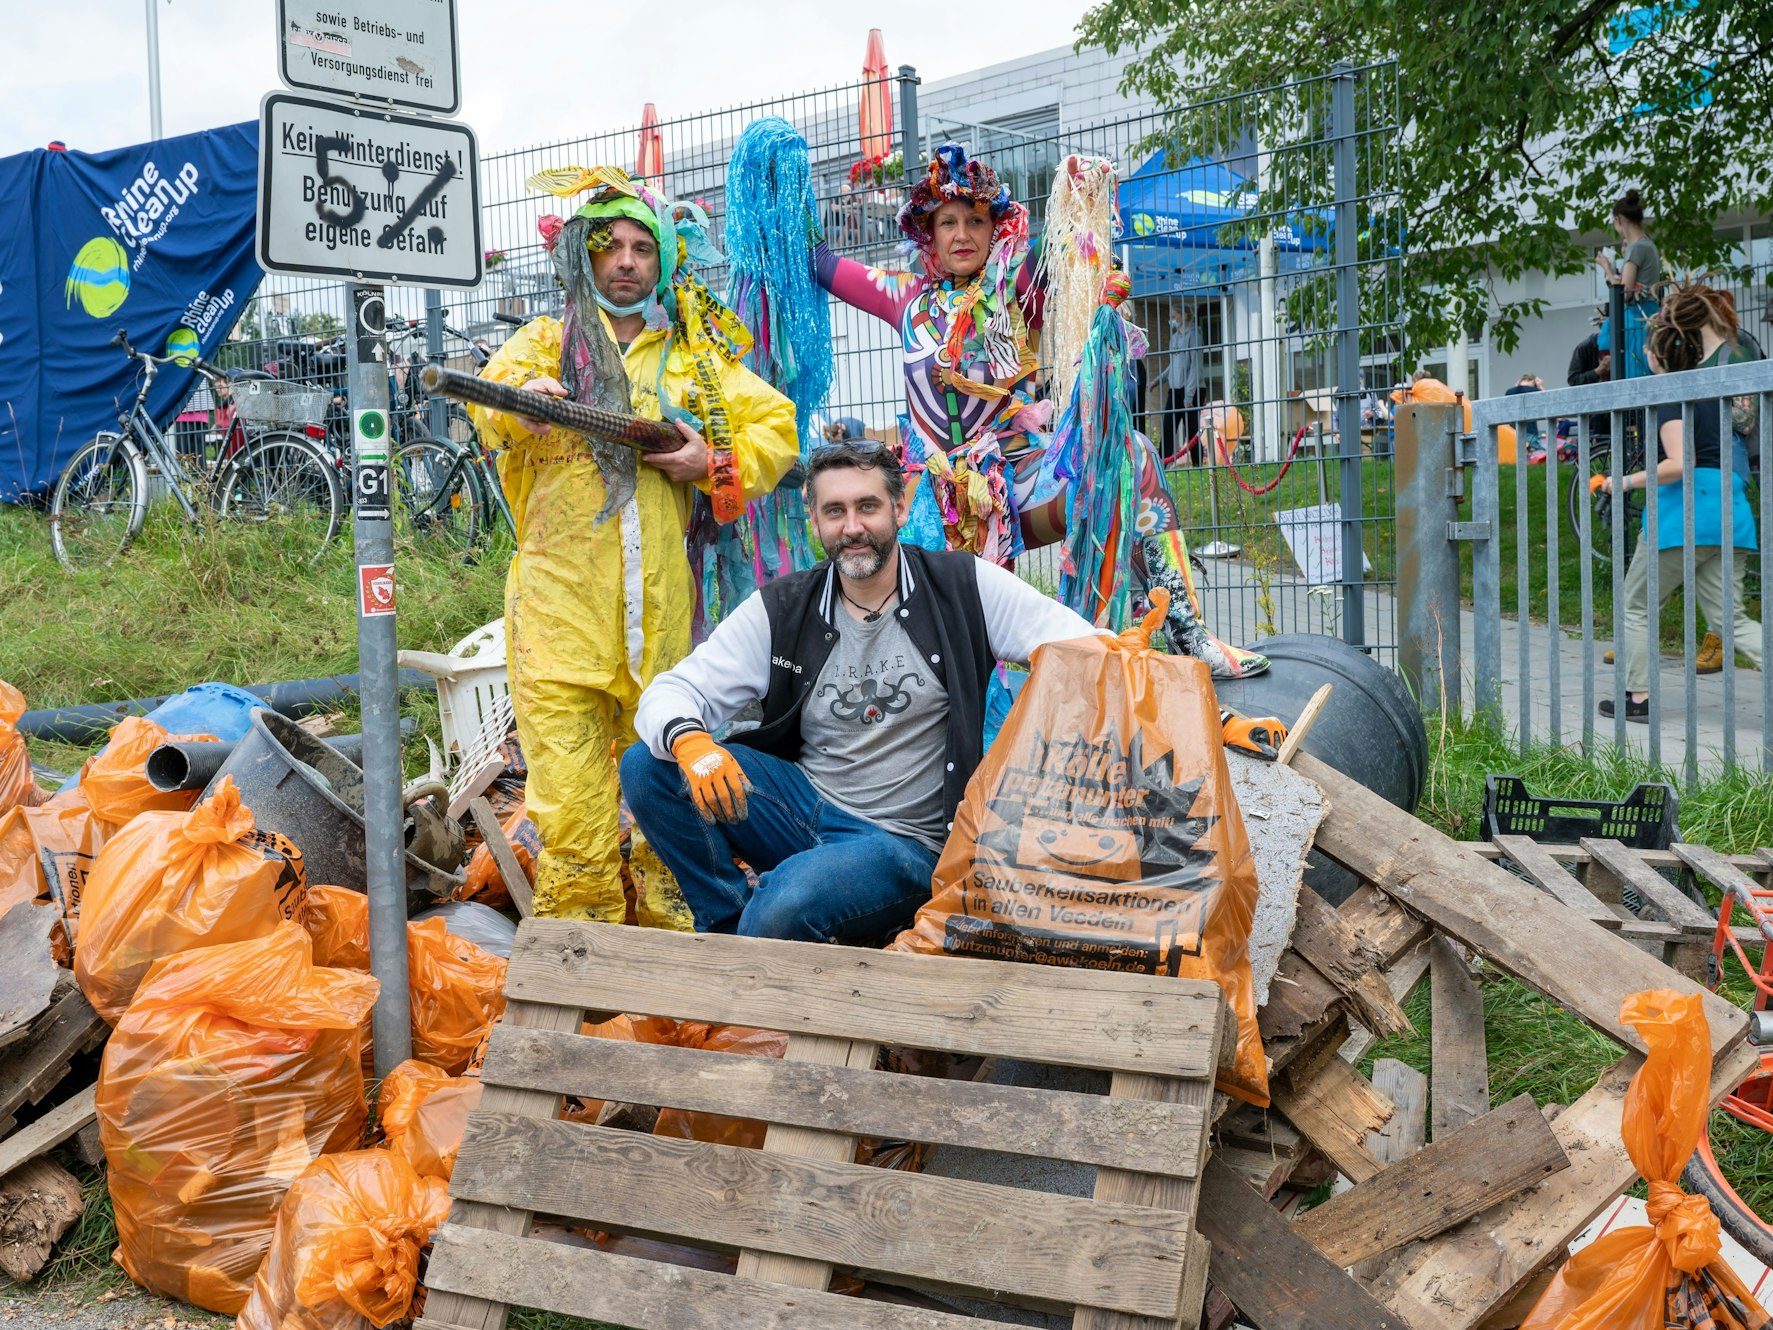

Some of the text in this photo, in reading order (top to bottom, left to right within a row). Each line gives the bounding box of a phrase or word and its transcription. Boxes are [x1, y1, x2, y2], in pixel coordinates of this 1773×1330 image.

[316, 11, 347, 28] sowie
[353, 17, 402, 39] Betriebs-
[406, 31, 425, 45] und
[311, 52, 433, 89] Versorgungsdienst frei
[282, 121, 326, 154] Kei
[457, 150, 464, 175] !
[101, 161, 160, 237] Rhine
[305, 216, 371, 251] eigene
[180, 290, 211, 329] Rhine
[358, 468, 388, 495] G1
[1043, 741, 1127, 785] Kölle
[1001, 771, 1150, 809] putzmunter
[1075, 811, 1099, 823] alle
[1102, 815, 1146, 828] machen
[1149, 817, 1175, 828] mit!
[973, 870, 1192, 915] Sauberkeitsaktionen
[973, 893, 987, 911] in
[991, 896, 1042, 920] allen
[957, 919, 982, 935] Jetzt
[1054, 936, 1080, 950] und
[1081, 940, 1149, 958] anmelden:
